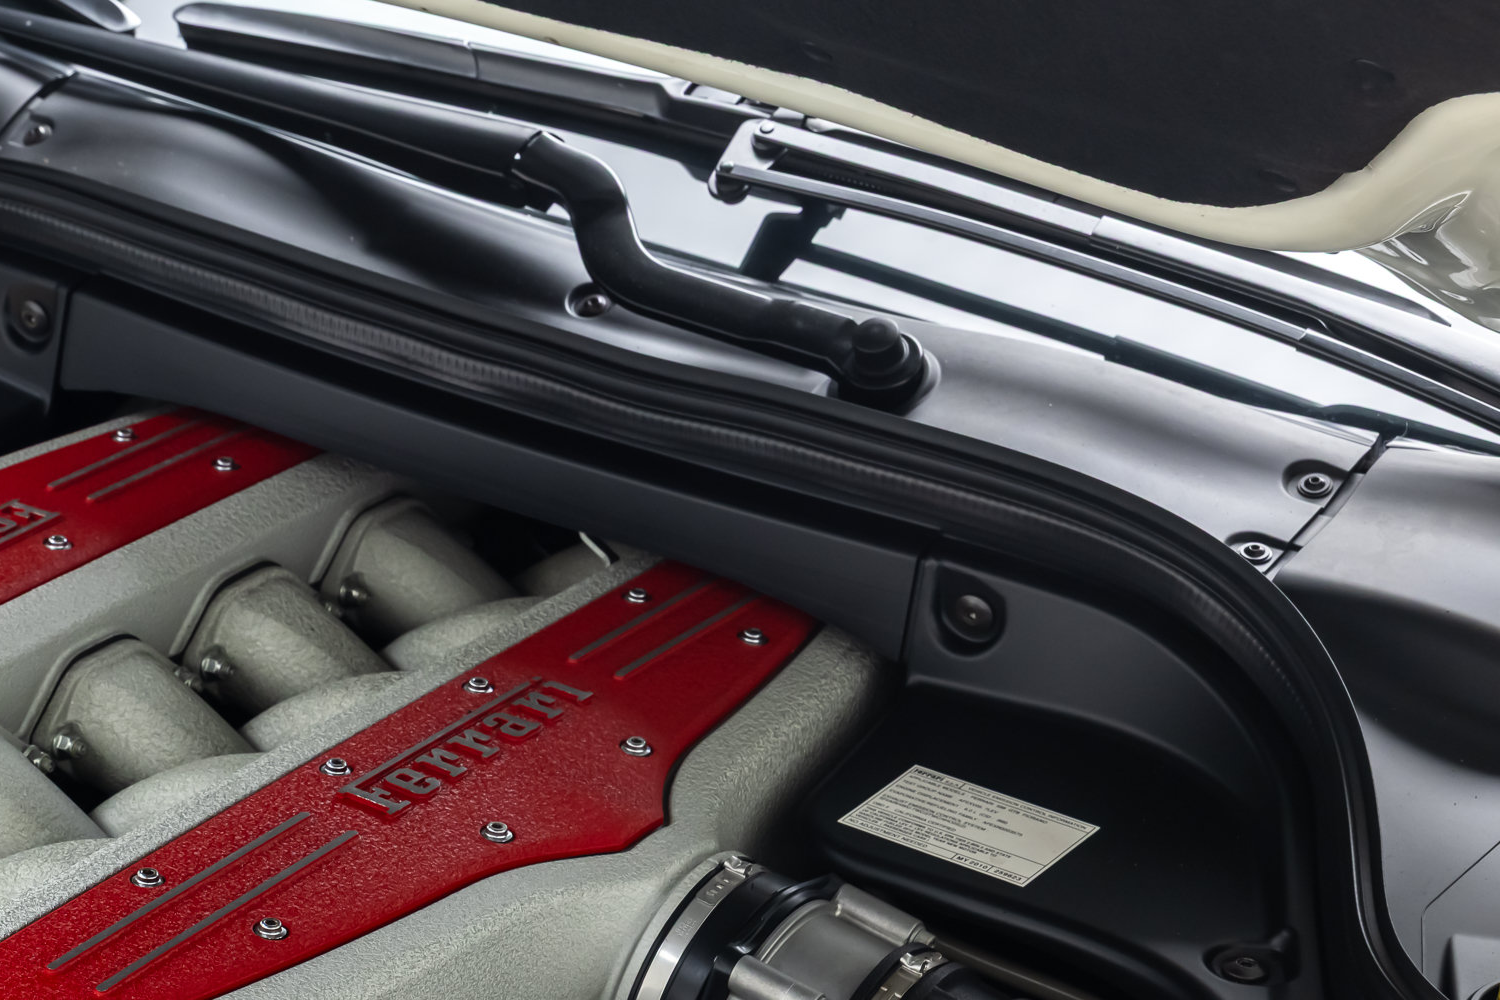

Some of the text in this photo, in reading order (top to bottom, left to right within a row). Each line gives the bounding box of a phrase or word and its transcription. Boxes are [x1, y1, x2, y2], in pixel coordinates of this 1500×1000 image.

[336, 676, 594, 817] Ferrari
[966, 787, 1087, 830] VEHICLE EMISSION CONTROL INFORMATION
[858, 822, 901, 838] ADJUSTMENT
[900, 837, 928, 848] NEEDED
[968, 861, 989, 869] 2010
